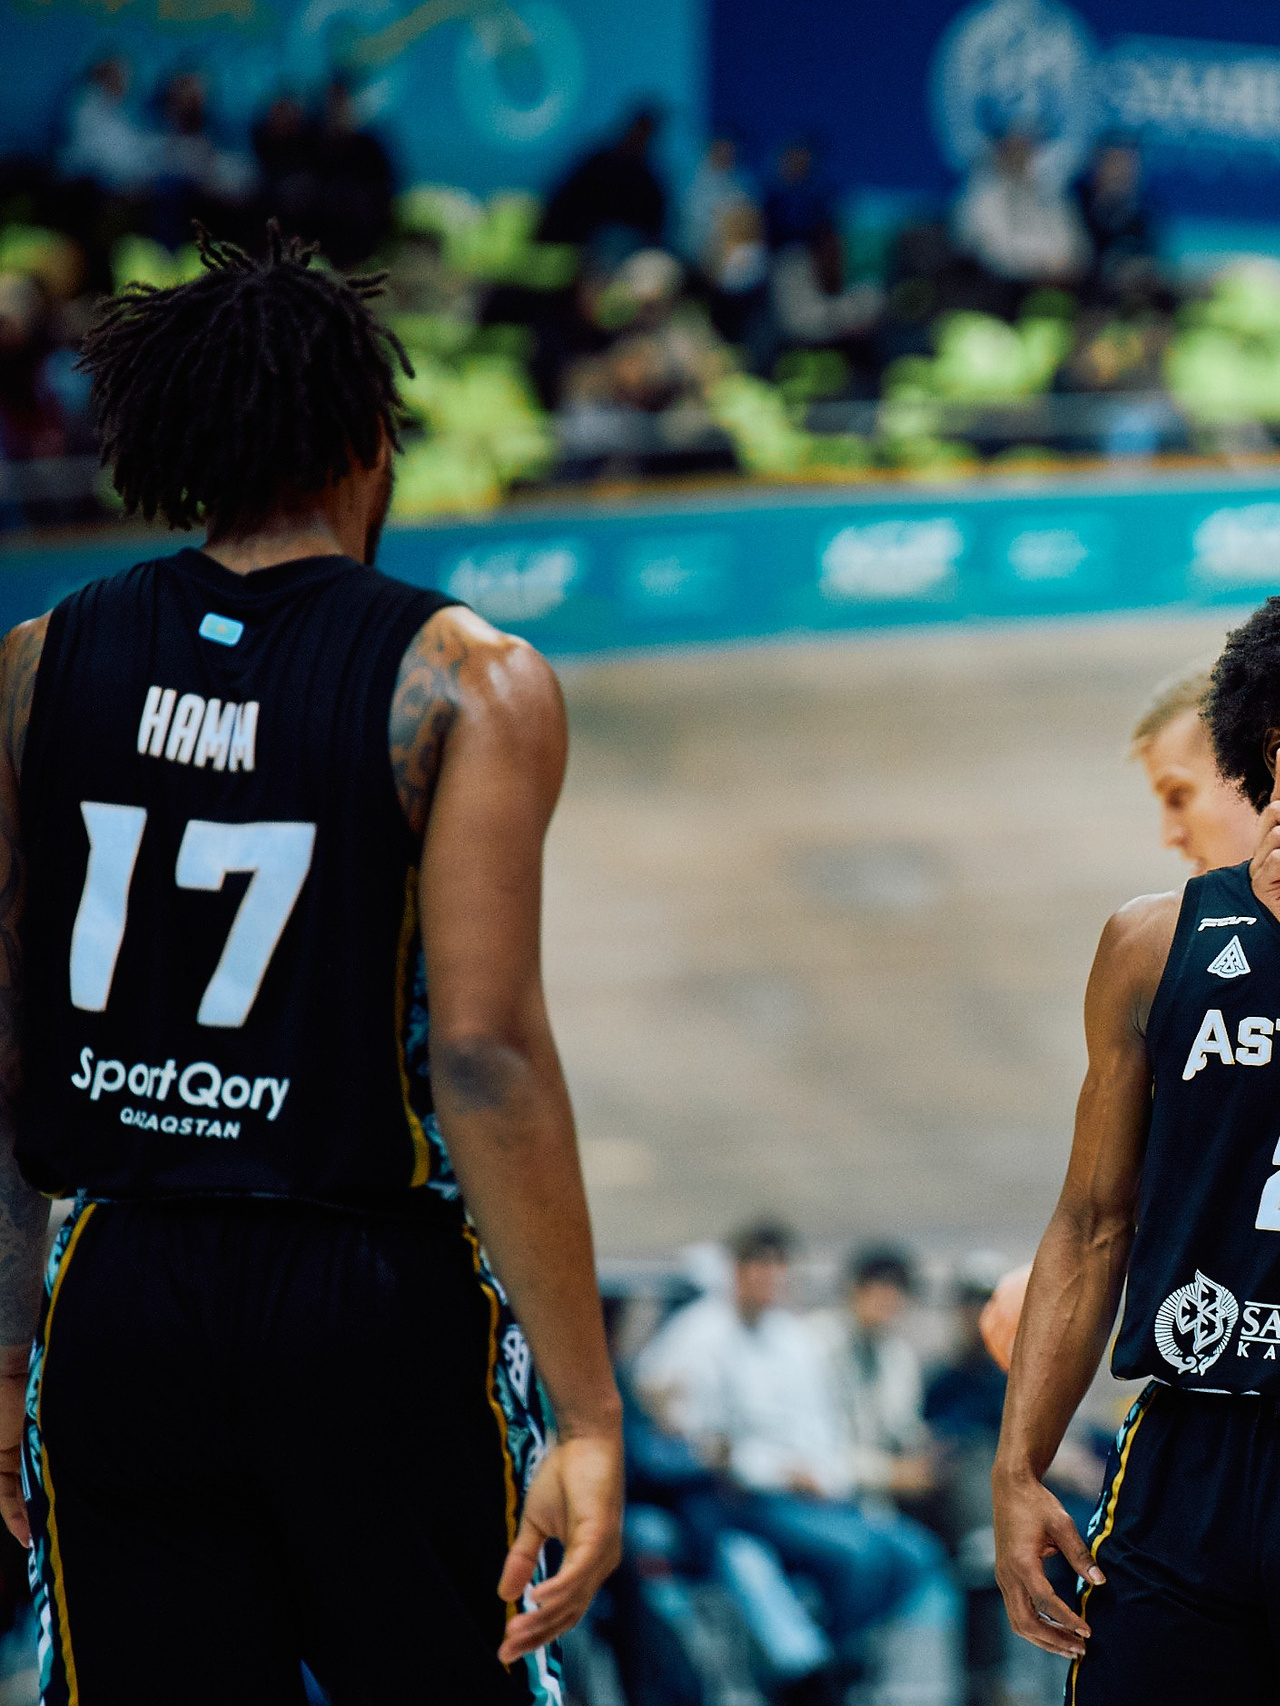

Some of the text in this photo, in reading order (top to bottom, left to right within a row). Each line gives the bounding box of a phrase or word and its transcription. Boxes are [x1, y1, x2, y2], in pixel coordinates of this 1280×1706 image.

[138, 686, 259, 771] HAMM
[70, 801, 316, 1027] 17
[71, 1047, 289, 1120] SportQory
[120, 1107, 240, 1139] QAZAQSTAN
